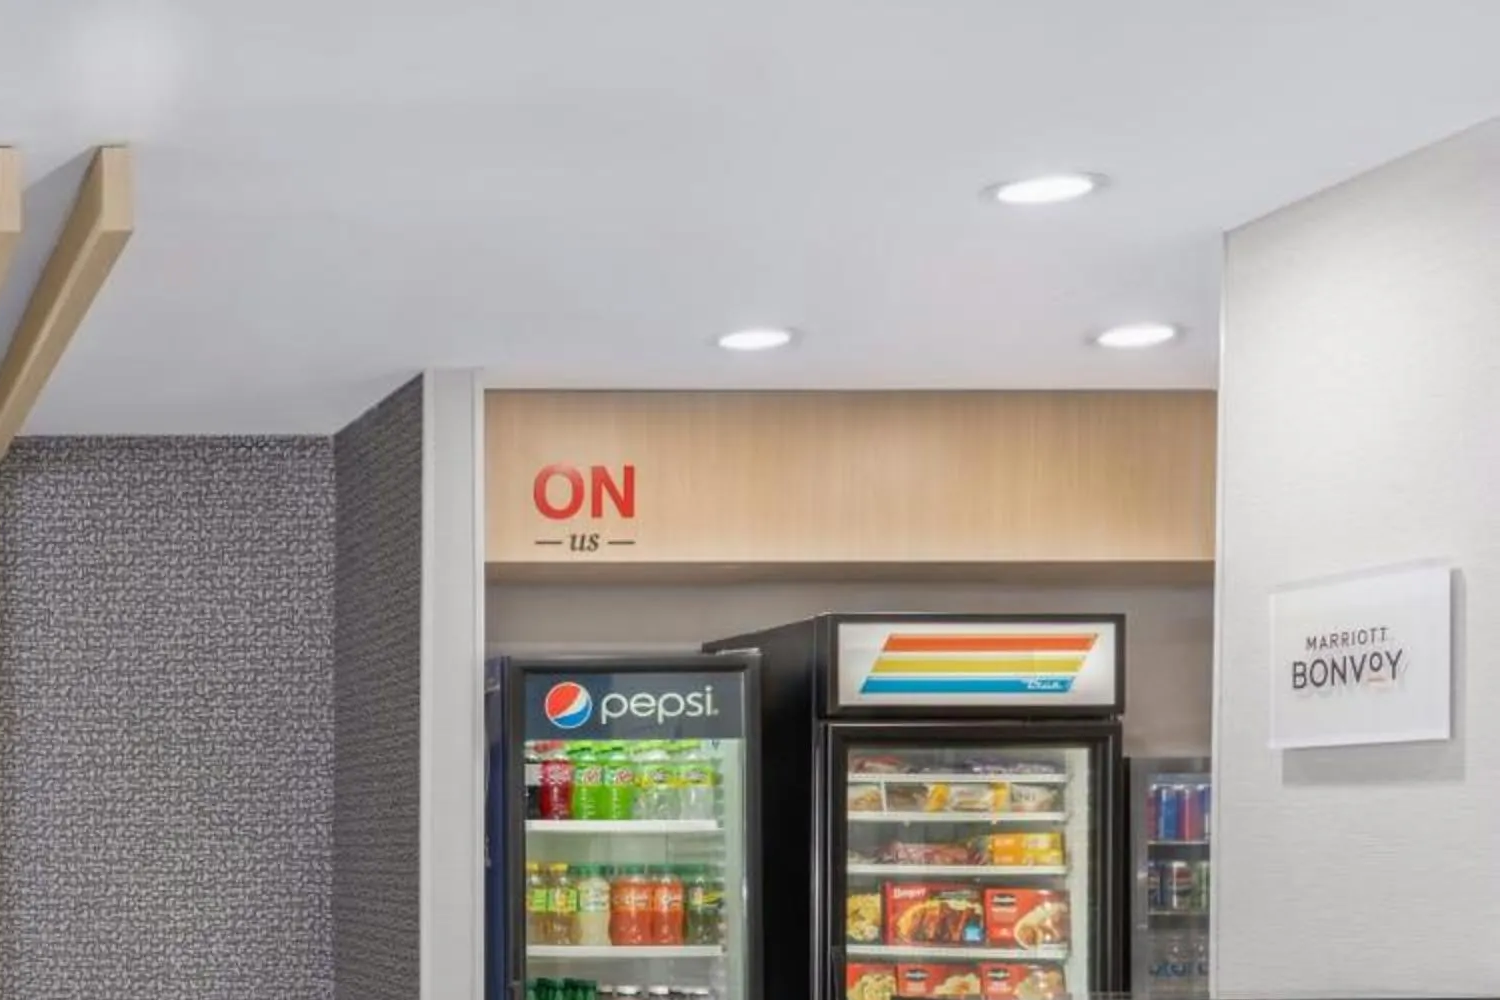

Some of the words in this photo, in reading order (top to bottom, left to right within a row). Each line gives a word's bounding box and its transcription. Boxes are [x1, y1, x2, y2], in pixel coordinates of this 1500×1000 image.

[533, 464, 635, 520] ON
[569, 533, 600, 552] us
[1305, 626, 1389, 650] MARRIOTT
[1292, 648, 1403, 690] BONVOY
[601, 685, 713, 725] pepsi
